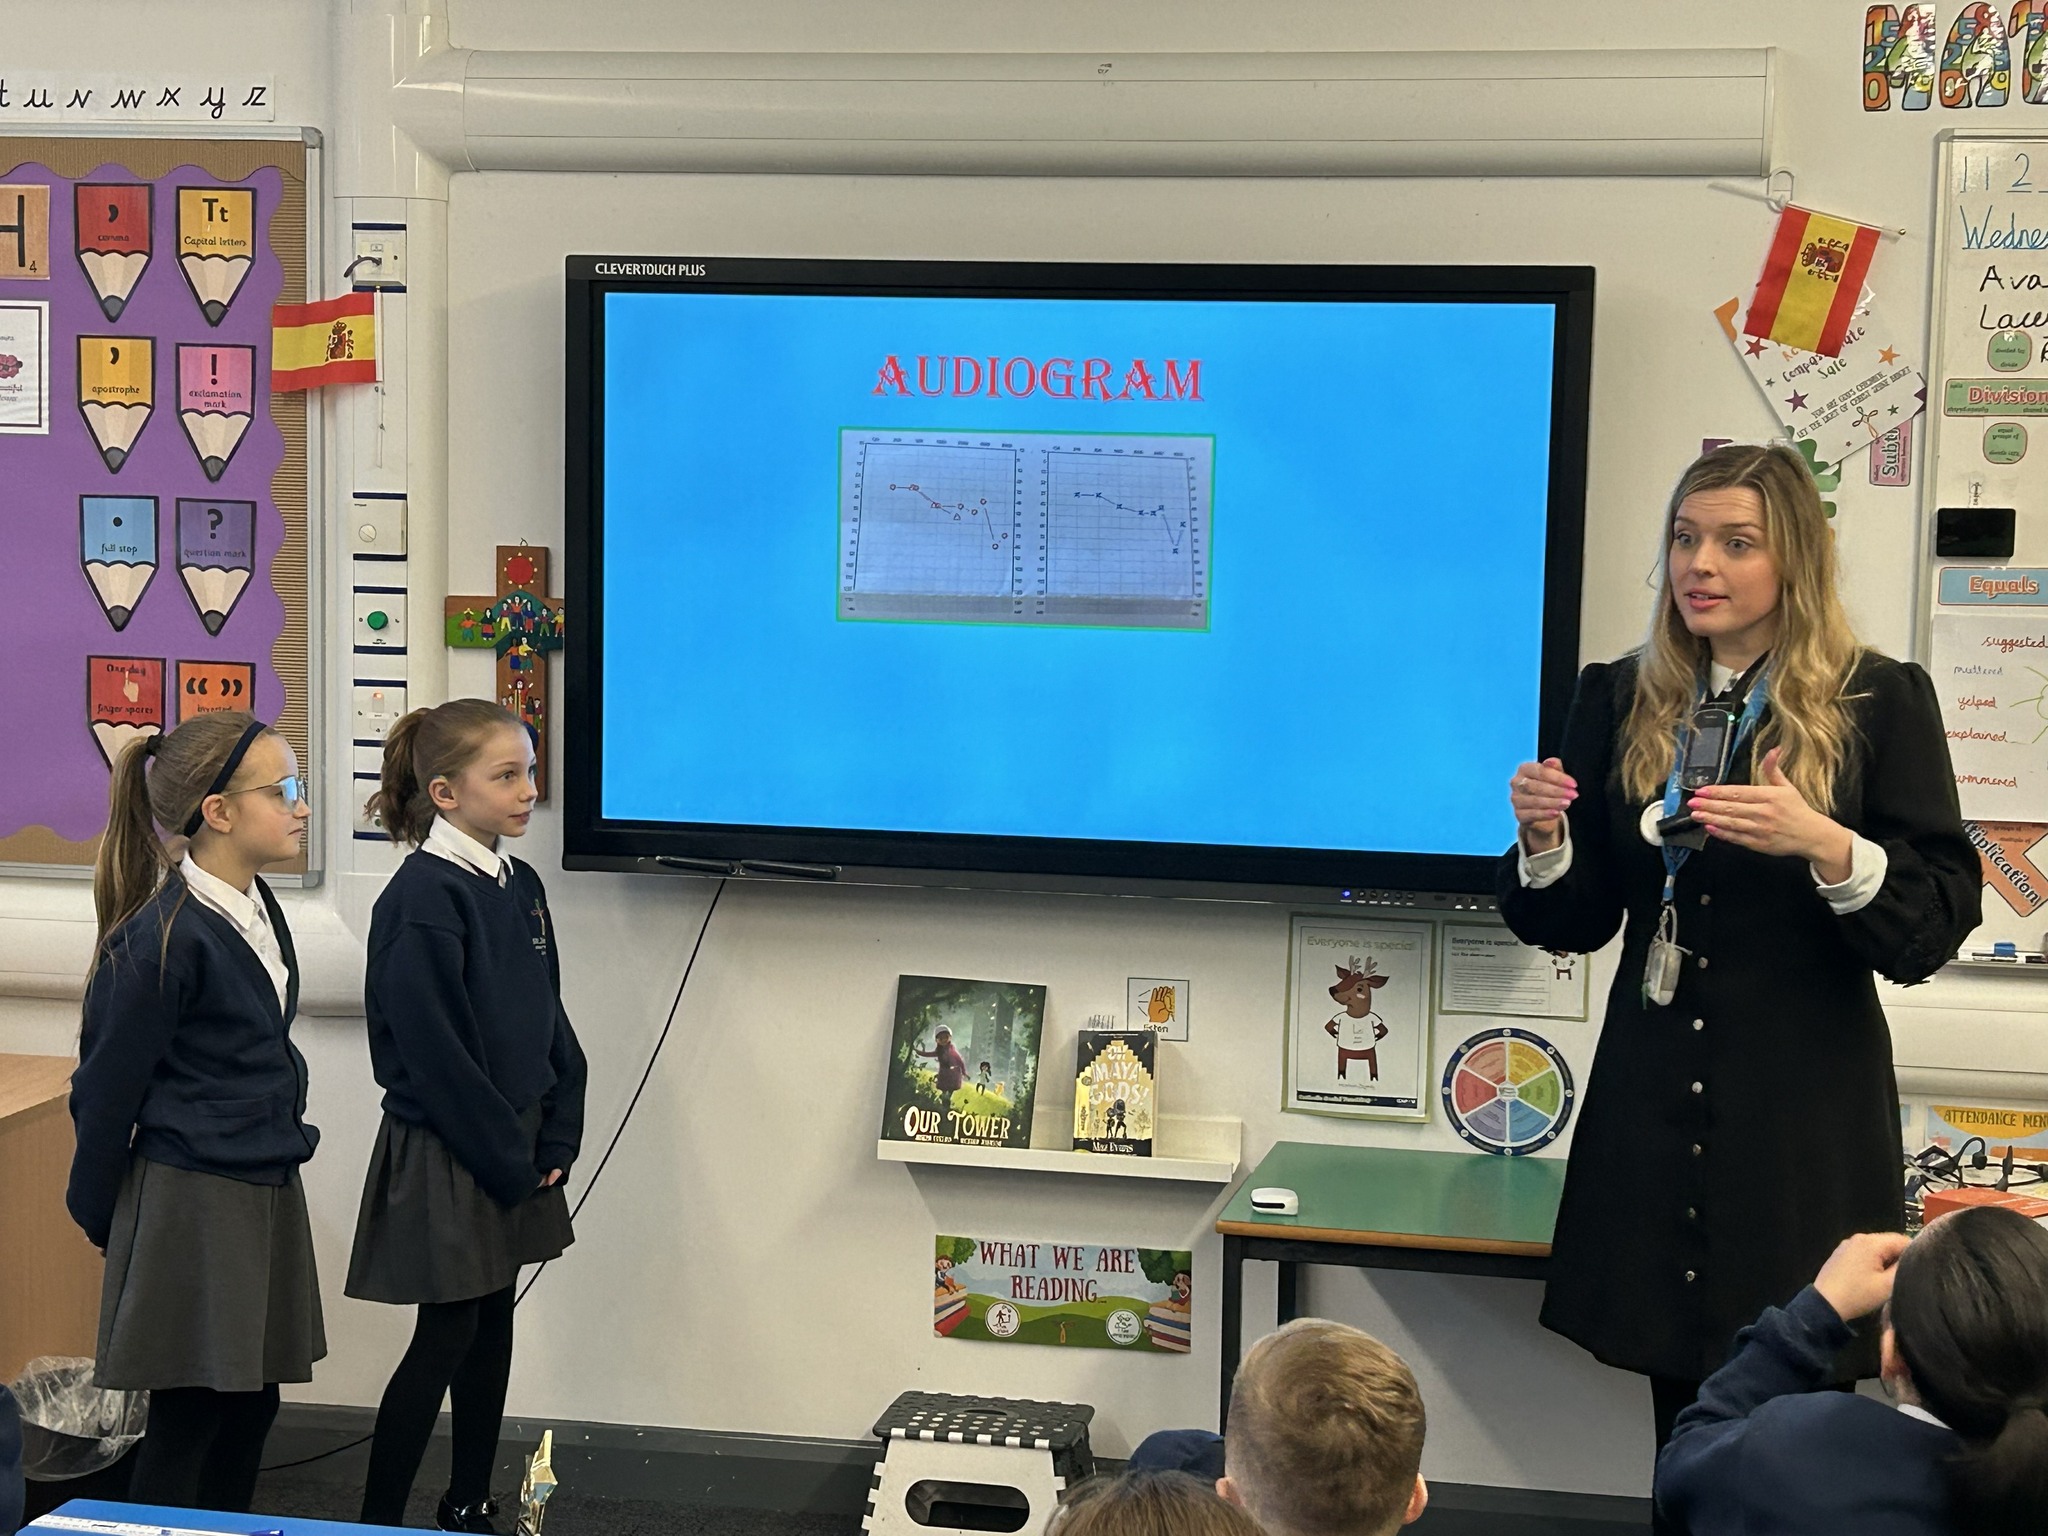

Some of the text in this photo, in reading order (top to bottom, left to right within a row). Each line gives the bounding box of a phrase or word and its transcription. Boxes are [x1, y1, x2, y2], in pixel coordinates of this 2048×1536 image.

[184, 235, 216, 248] Capital
[595, 262, 706, 276] CLEVERTOUCH PLUS
[872, 354, 1205, 402] AUDIOGRAM
[92, 385, 140, 396] apostrophe
[189, 390, 242, 398] exclamation
[1968, 386, 2048, 404] Division
[102, 543, 138, 556] full stop
[184, 549, 221, 558] question
[1969, 575, 2039, 597] Equals
[1981, 635, 2048, 653] suggested
[1307, 936, 1359, 948] Everyone
[1091, 1062, 1140, 1082] MAYA
[904, 1105, 1011, 1140] OUR TOWER
[1944, 1109, 2048, 1128] ATTENDANCE MEN
[979, 1240, 1135, 1274] WHAT WE ARE
[1010, 1275, 1097, 1303] READING
